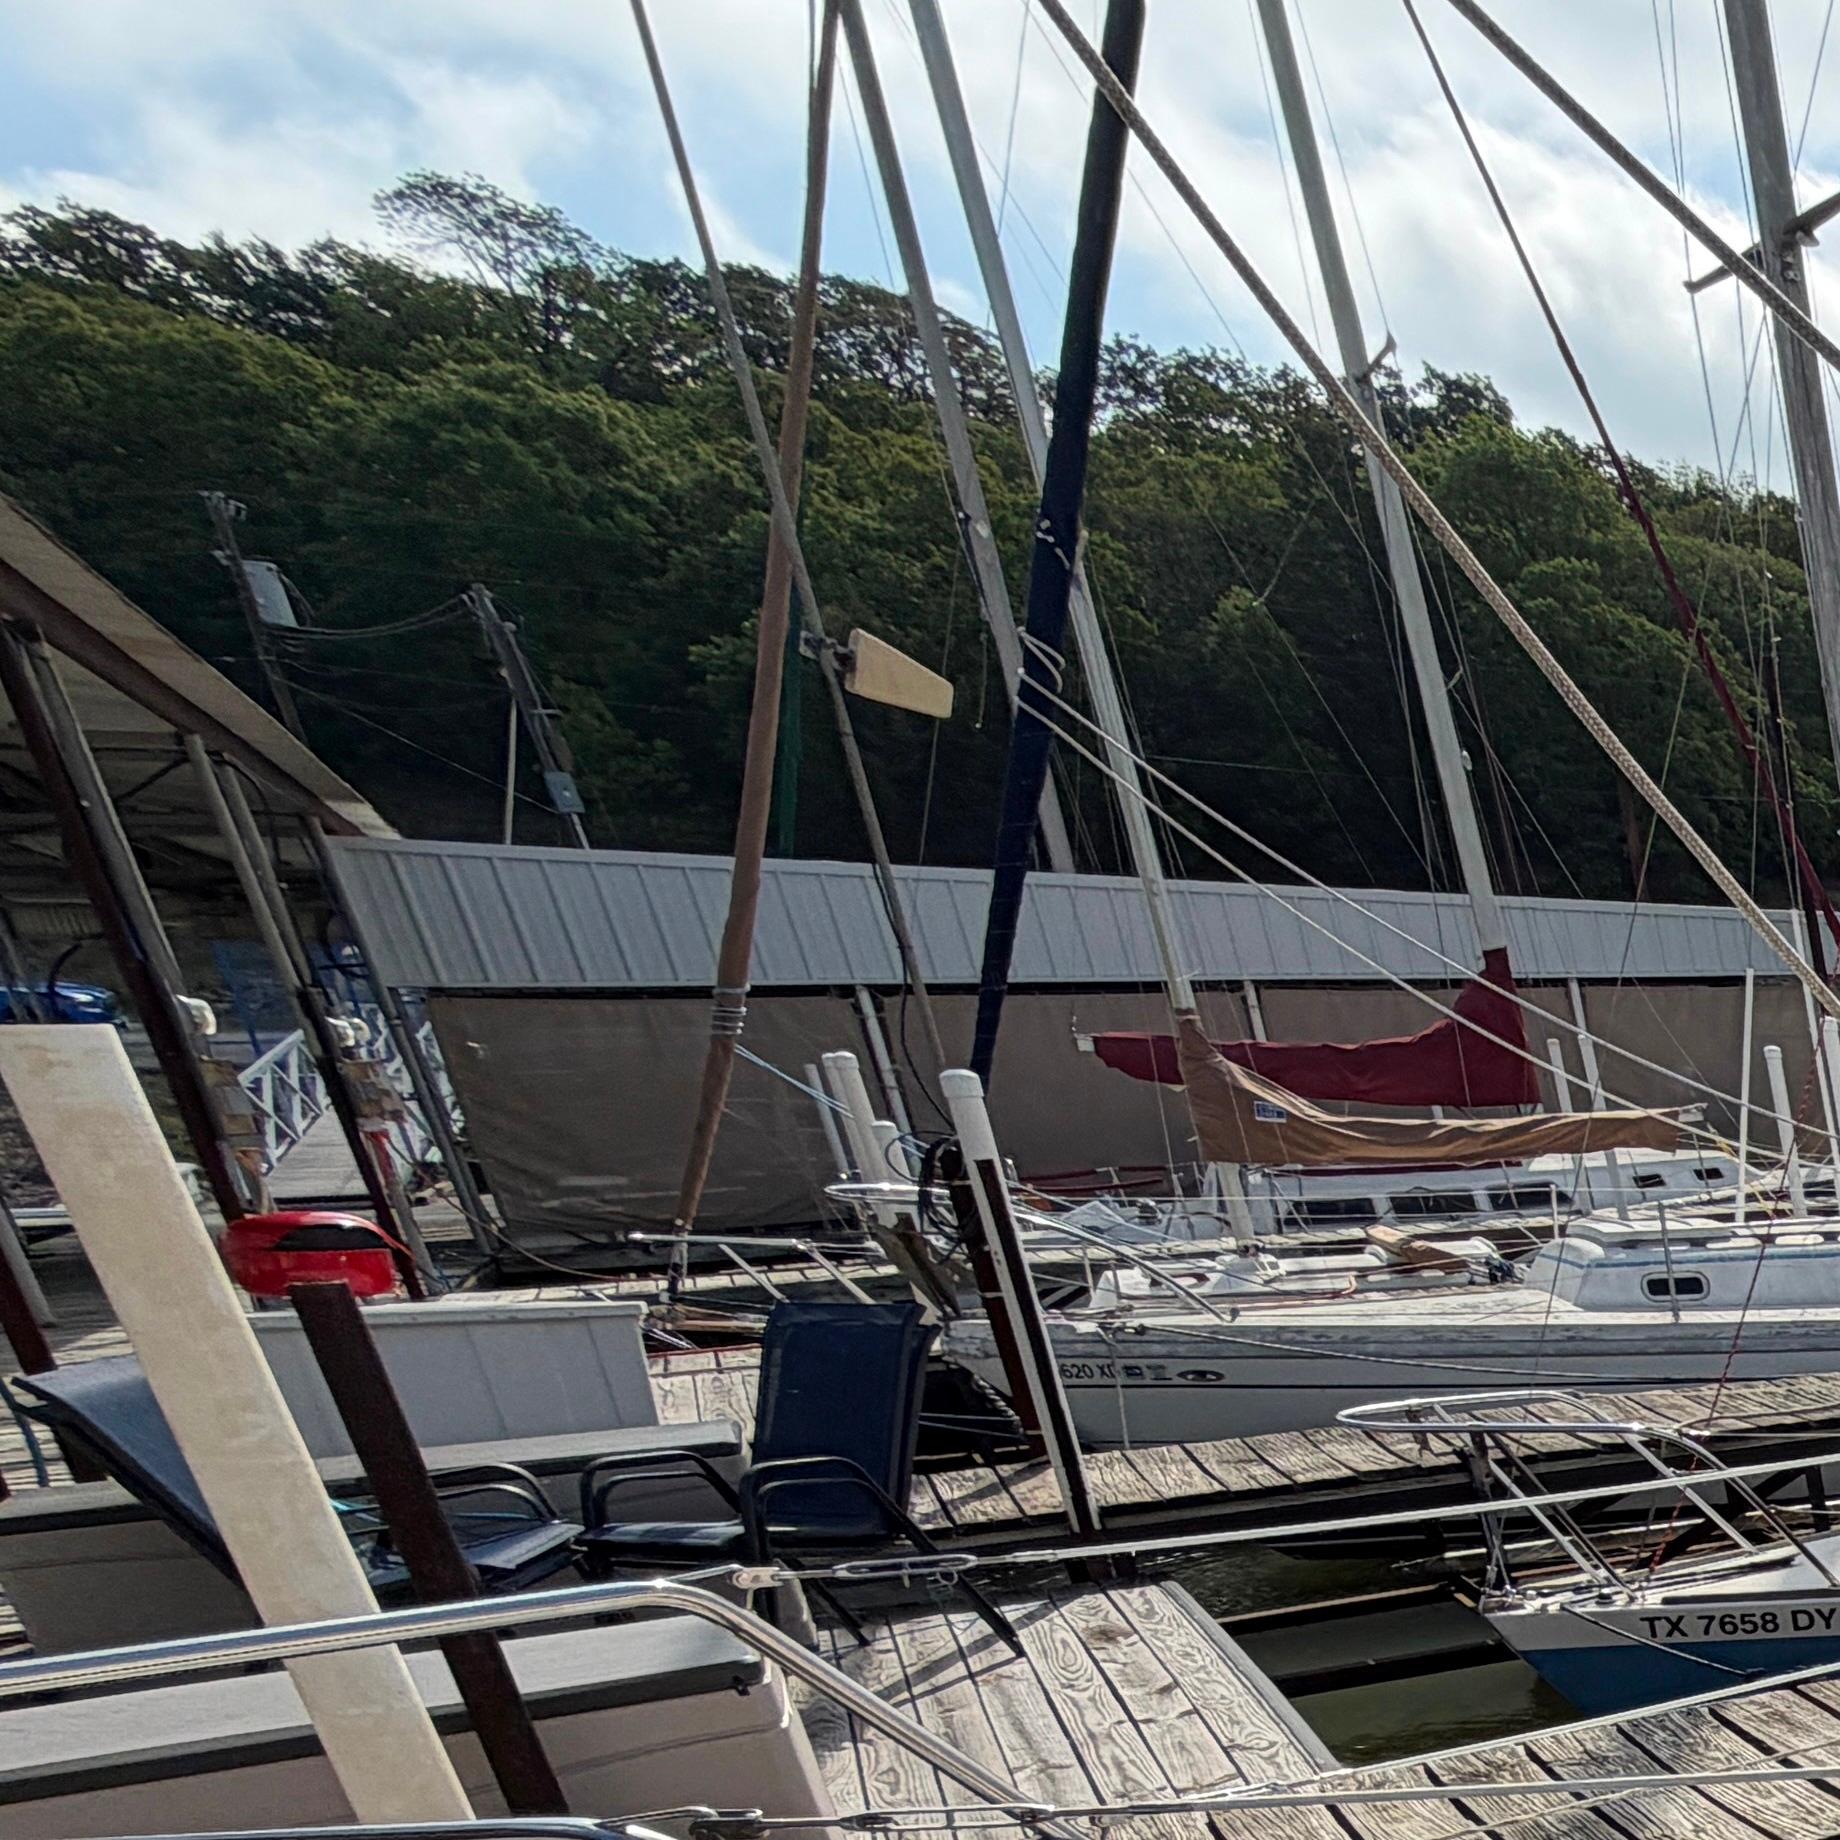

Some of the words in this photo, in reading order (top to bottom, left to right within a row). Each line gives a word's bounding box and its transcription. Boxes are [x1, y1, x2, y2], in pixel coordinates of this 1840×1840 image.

[1639, 1615, 1688, 1639] TX
[1696, 1612, 1780, 1636] 7658
[1790, 1608, 1837, 1632] DY
